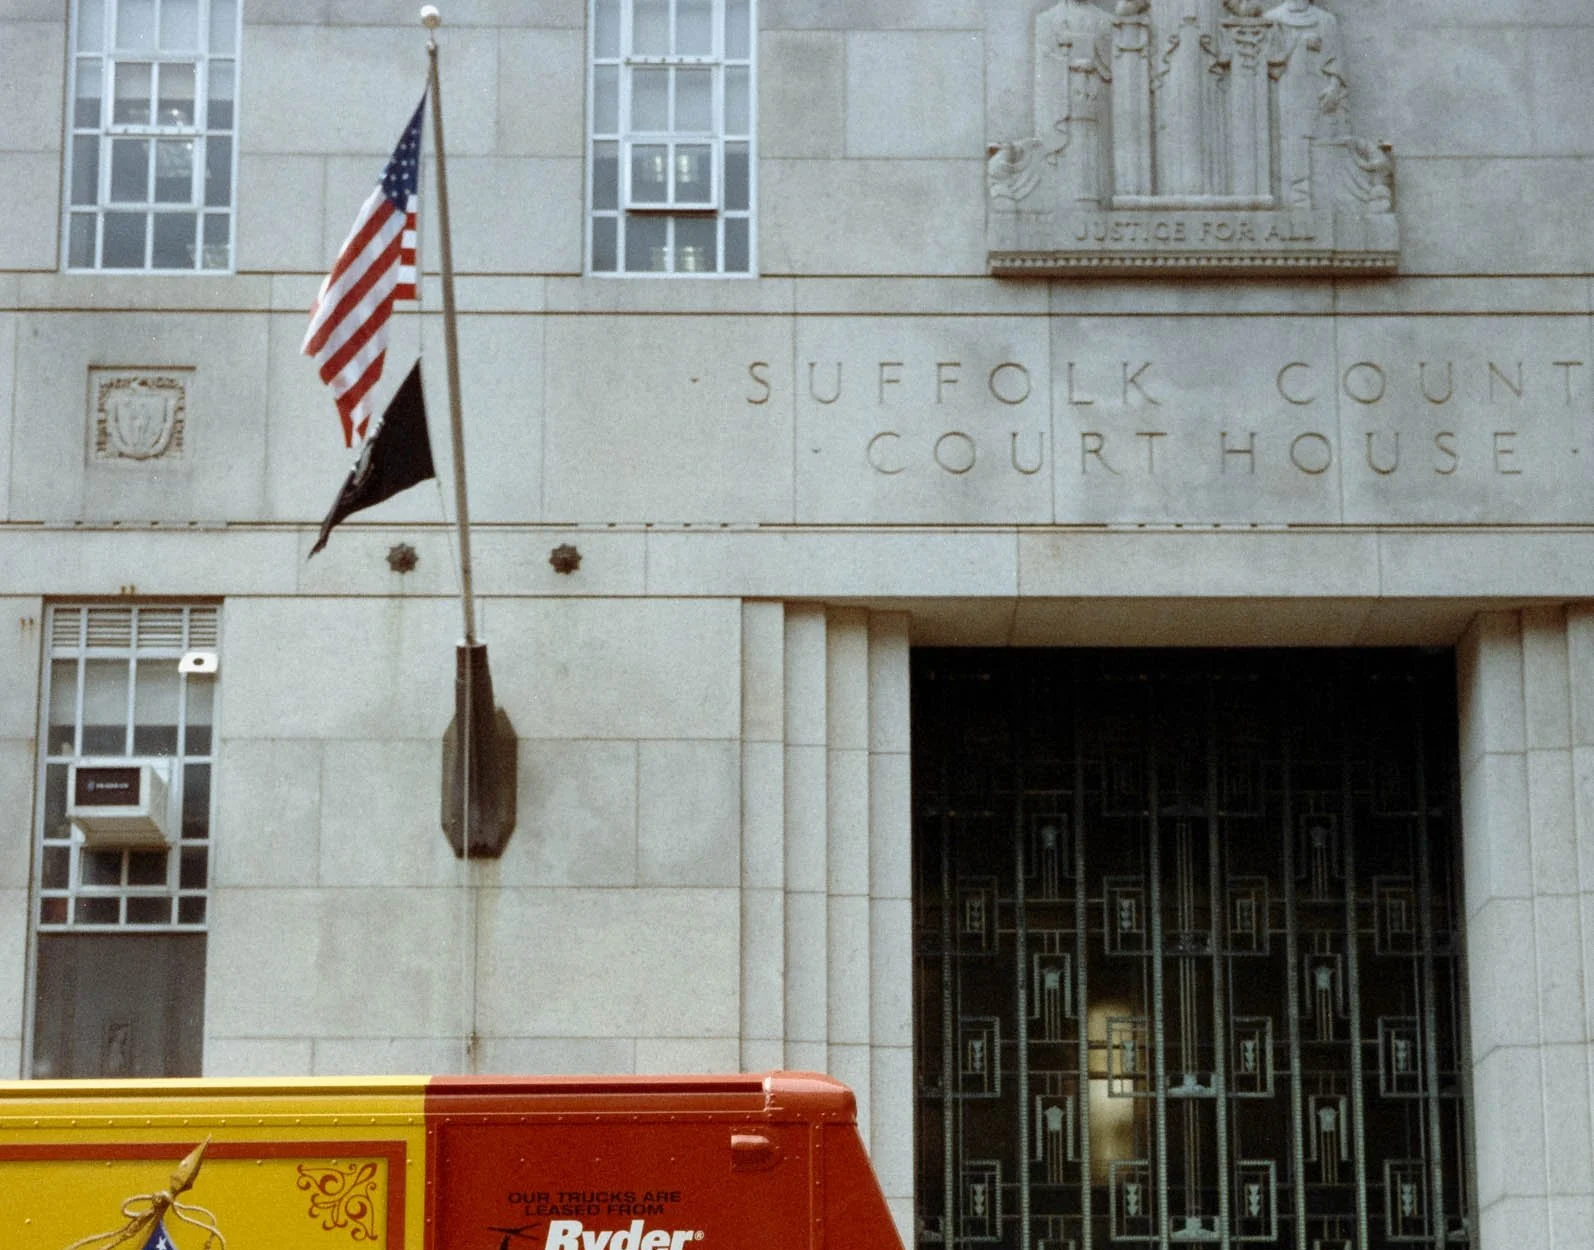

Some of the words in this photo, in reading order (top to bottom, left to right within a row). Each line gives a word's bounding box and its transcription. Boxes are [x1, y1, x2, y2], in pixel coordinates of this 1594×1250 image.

[1076, 221, 1186, 242] JUSTICE
[1200, 221, 1256, 242] FOR
[1264, 221, 1315, 242] ALL
[746, 361, 1162, 406] SUFFOLK
[1276, 360, 1585, 406] COUNT
[867, 430, 1168, 476] COURT
[1220, 430, 1524, 476] HOUSE
[508, 1191, 550, 1205] OUR
[556, 1191, 636, 1204] TRUCKS
[643, 1191, 682, 1203] ARE
[524, 1203, 600, 1217] LEASED
[606, 1203, 665, 1216] FROM
